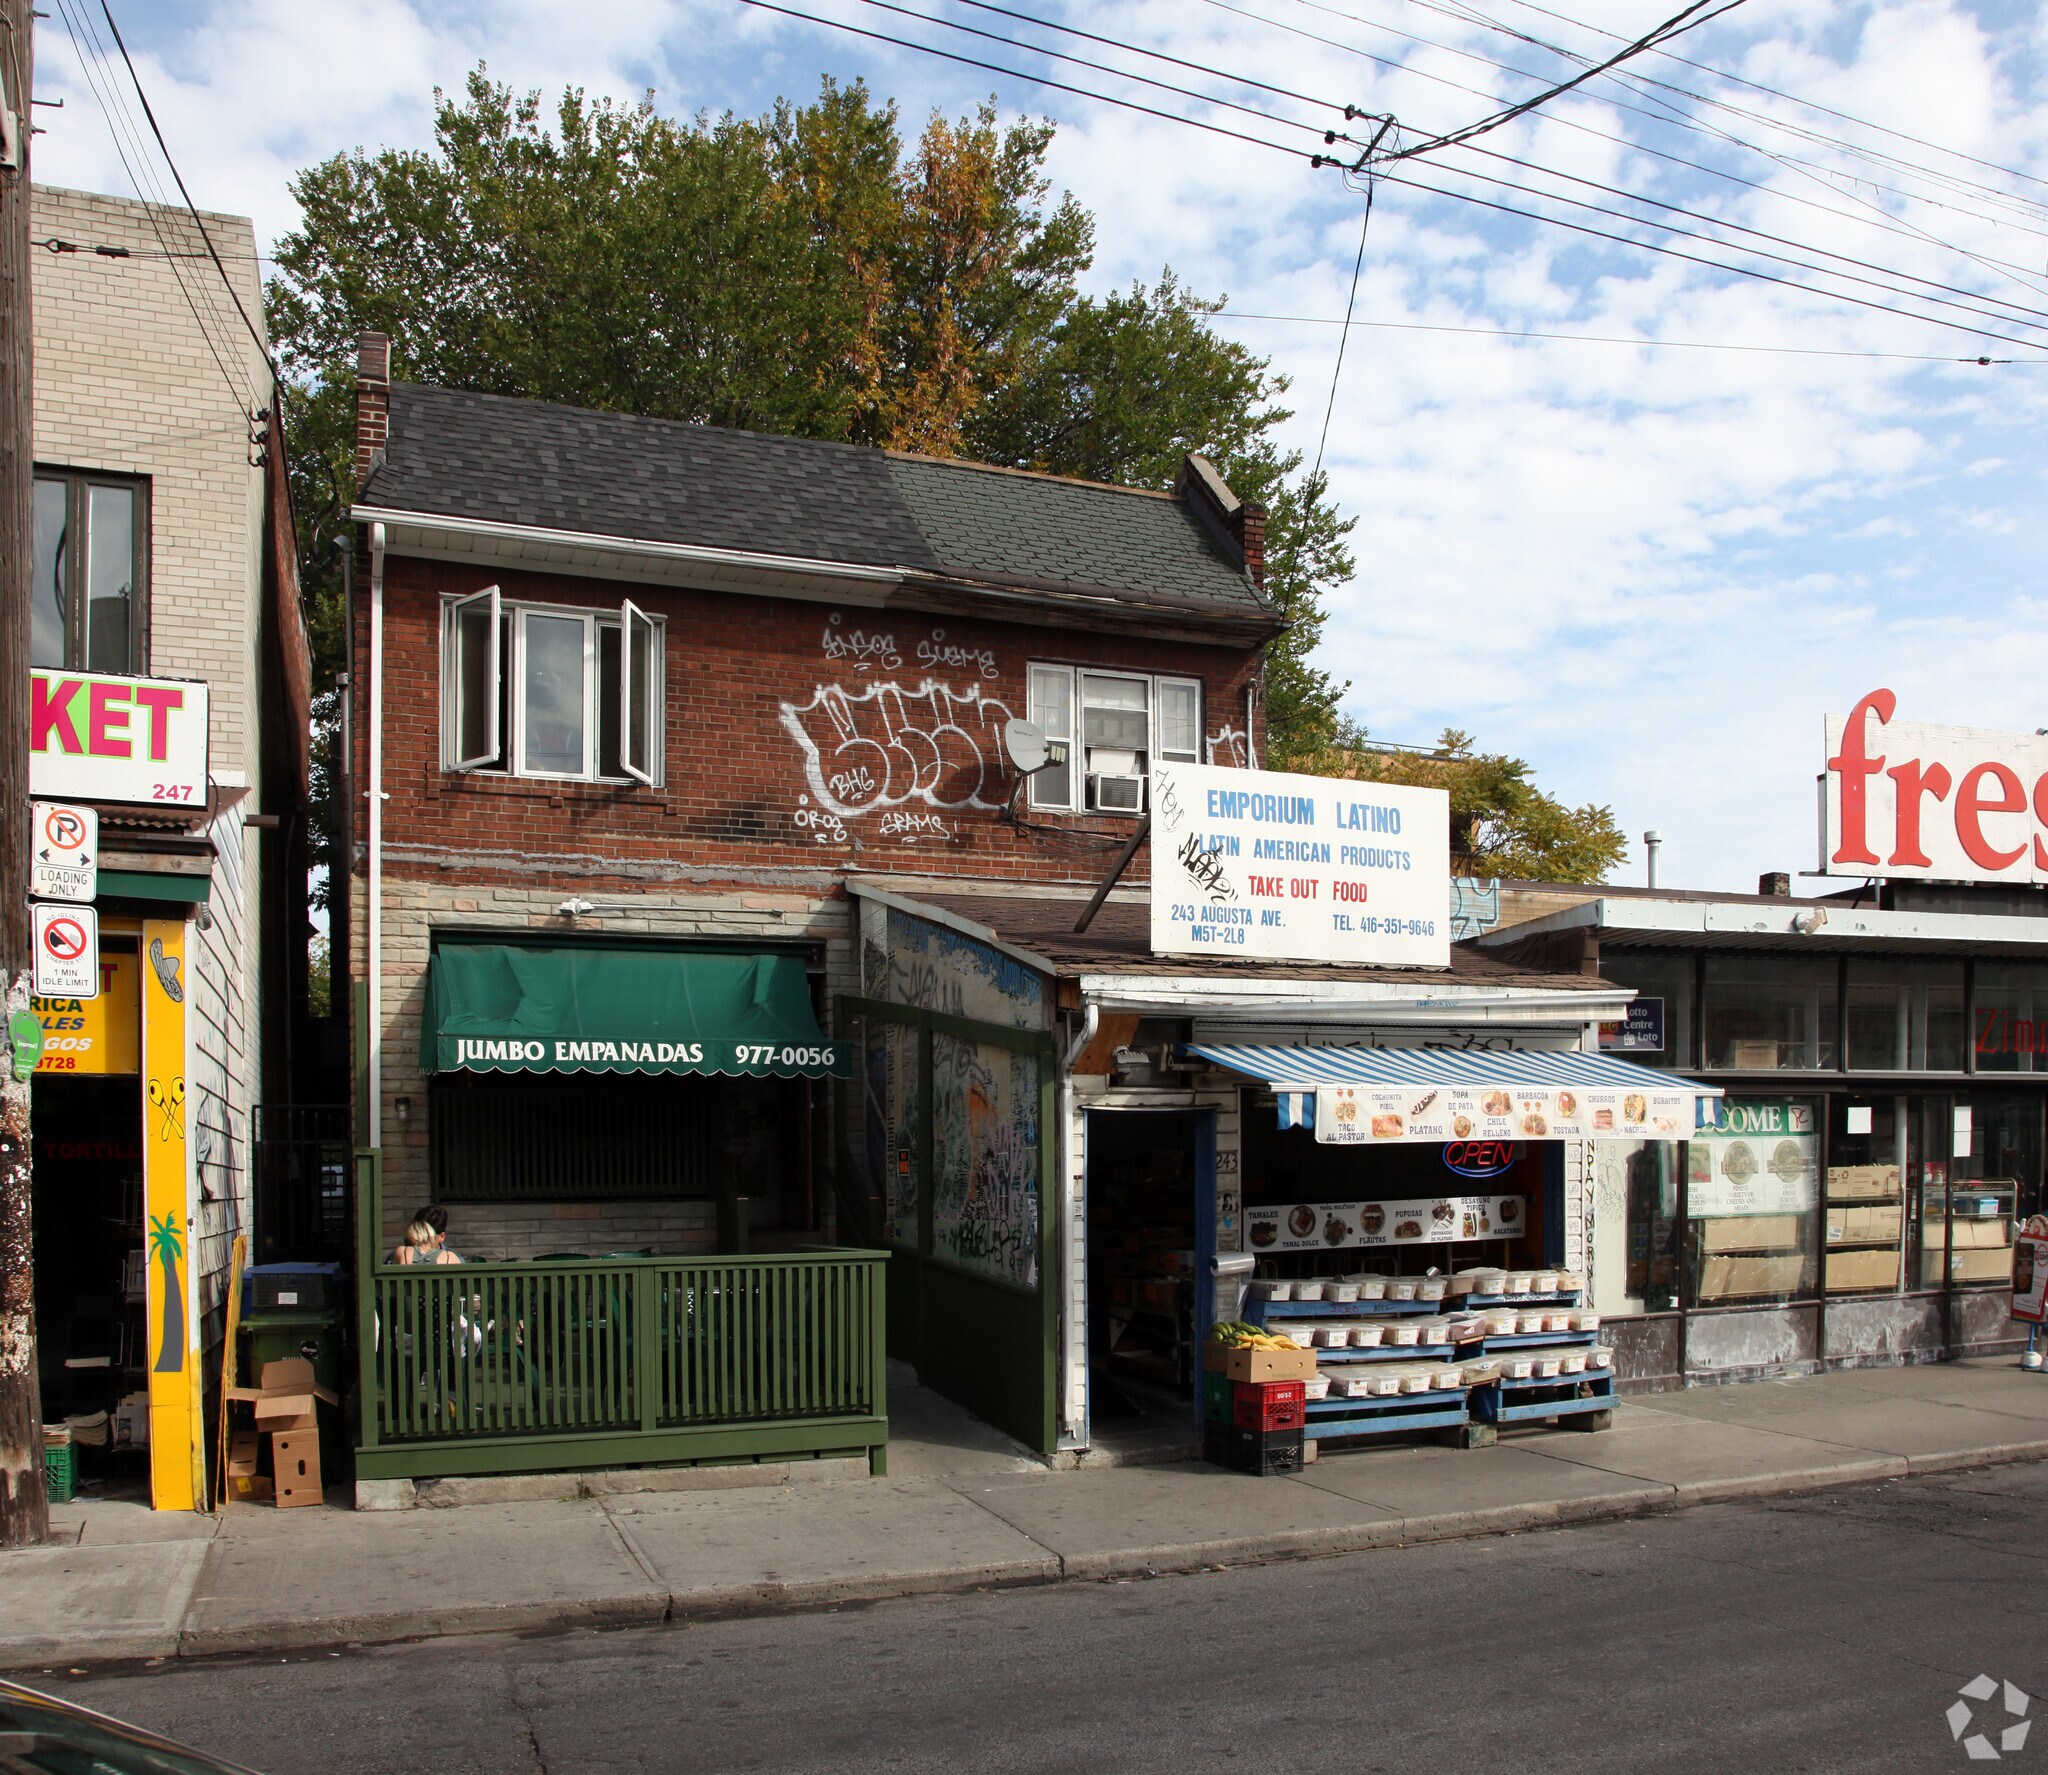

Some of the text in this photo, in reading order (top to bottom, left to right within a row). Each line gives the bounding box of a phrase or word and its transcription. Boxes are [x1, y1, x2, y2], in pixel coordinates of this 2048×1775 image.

[152, 784, 193, 801] 247
[1207, 789, 1315, 825] EMPORIUM
[1336, 801, 1400, 835] LATINO
[1199, 833, 1411, 871] LATIN AMERICAN PRODUCTS
[41, 869, 88, 885] LOADING
[1248, 875, 1284, 897] TAKE
[1291, 878, 1319, 899] OUT
[1333, 881, 1368, 903] FOOD
[47, 912, 81, 923] NO IDLING
[1171, 904, 1286, 927] 243 AUGUSTA AVE.
[1333, 914, 1435, 937] TEL. 416-351-9646
[1191, 925, 1245, 945] M5T-2L8
[61, 968, 78, 976] MIN
[42, 977, 89, 987] IDLE LIMIT
[1627, 1008, 1648, 1017] otto
[1623, 1019, 1654, 1029] Centre
[1638, 1031, 1658, 1042] Loto
[457, 1039, 835, 1066] JUMBO EMPANADAS 977-0056
[1452, 1091, 1469, 1099] SOPA
[1517, 1092, 1549, 1100] BARBACOA
[1587, 1095, 1616, 1103] CHURROS
[1653, 1097, 1681, 1105] BURRITOS
[1448, 1102, 1474, 1111] DE PATA
[1487, 1117, 1507, 1126] CHILE
[1338, 1123, 1356, 1132] TACO
[1409, 1125, 1443, 1135] PLATANO
[1553, 1126, 1580, 1135] TOSTADA
[1326, 1132, 1365, 1142] AL PASTOR
[1482, 1129, 1511, 1137] RELLENO
[1446, 1141, 1515, 1165] OPEN
[1460, 1196, 1491, 1205] DESAYUNO
[1248, 1211, 1279, 1220] TAMALES
[1395, 1209, 1423, 1218] PUPUSAS
[1301, 1239, 1319, 1247] DULCE
[1359, 1236, 1387, 1245] FLAUTAS
